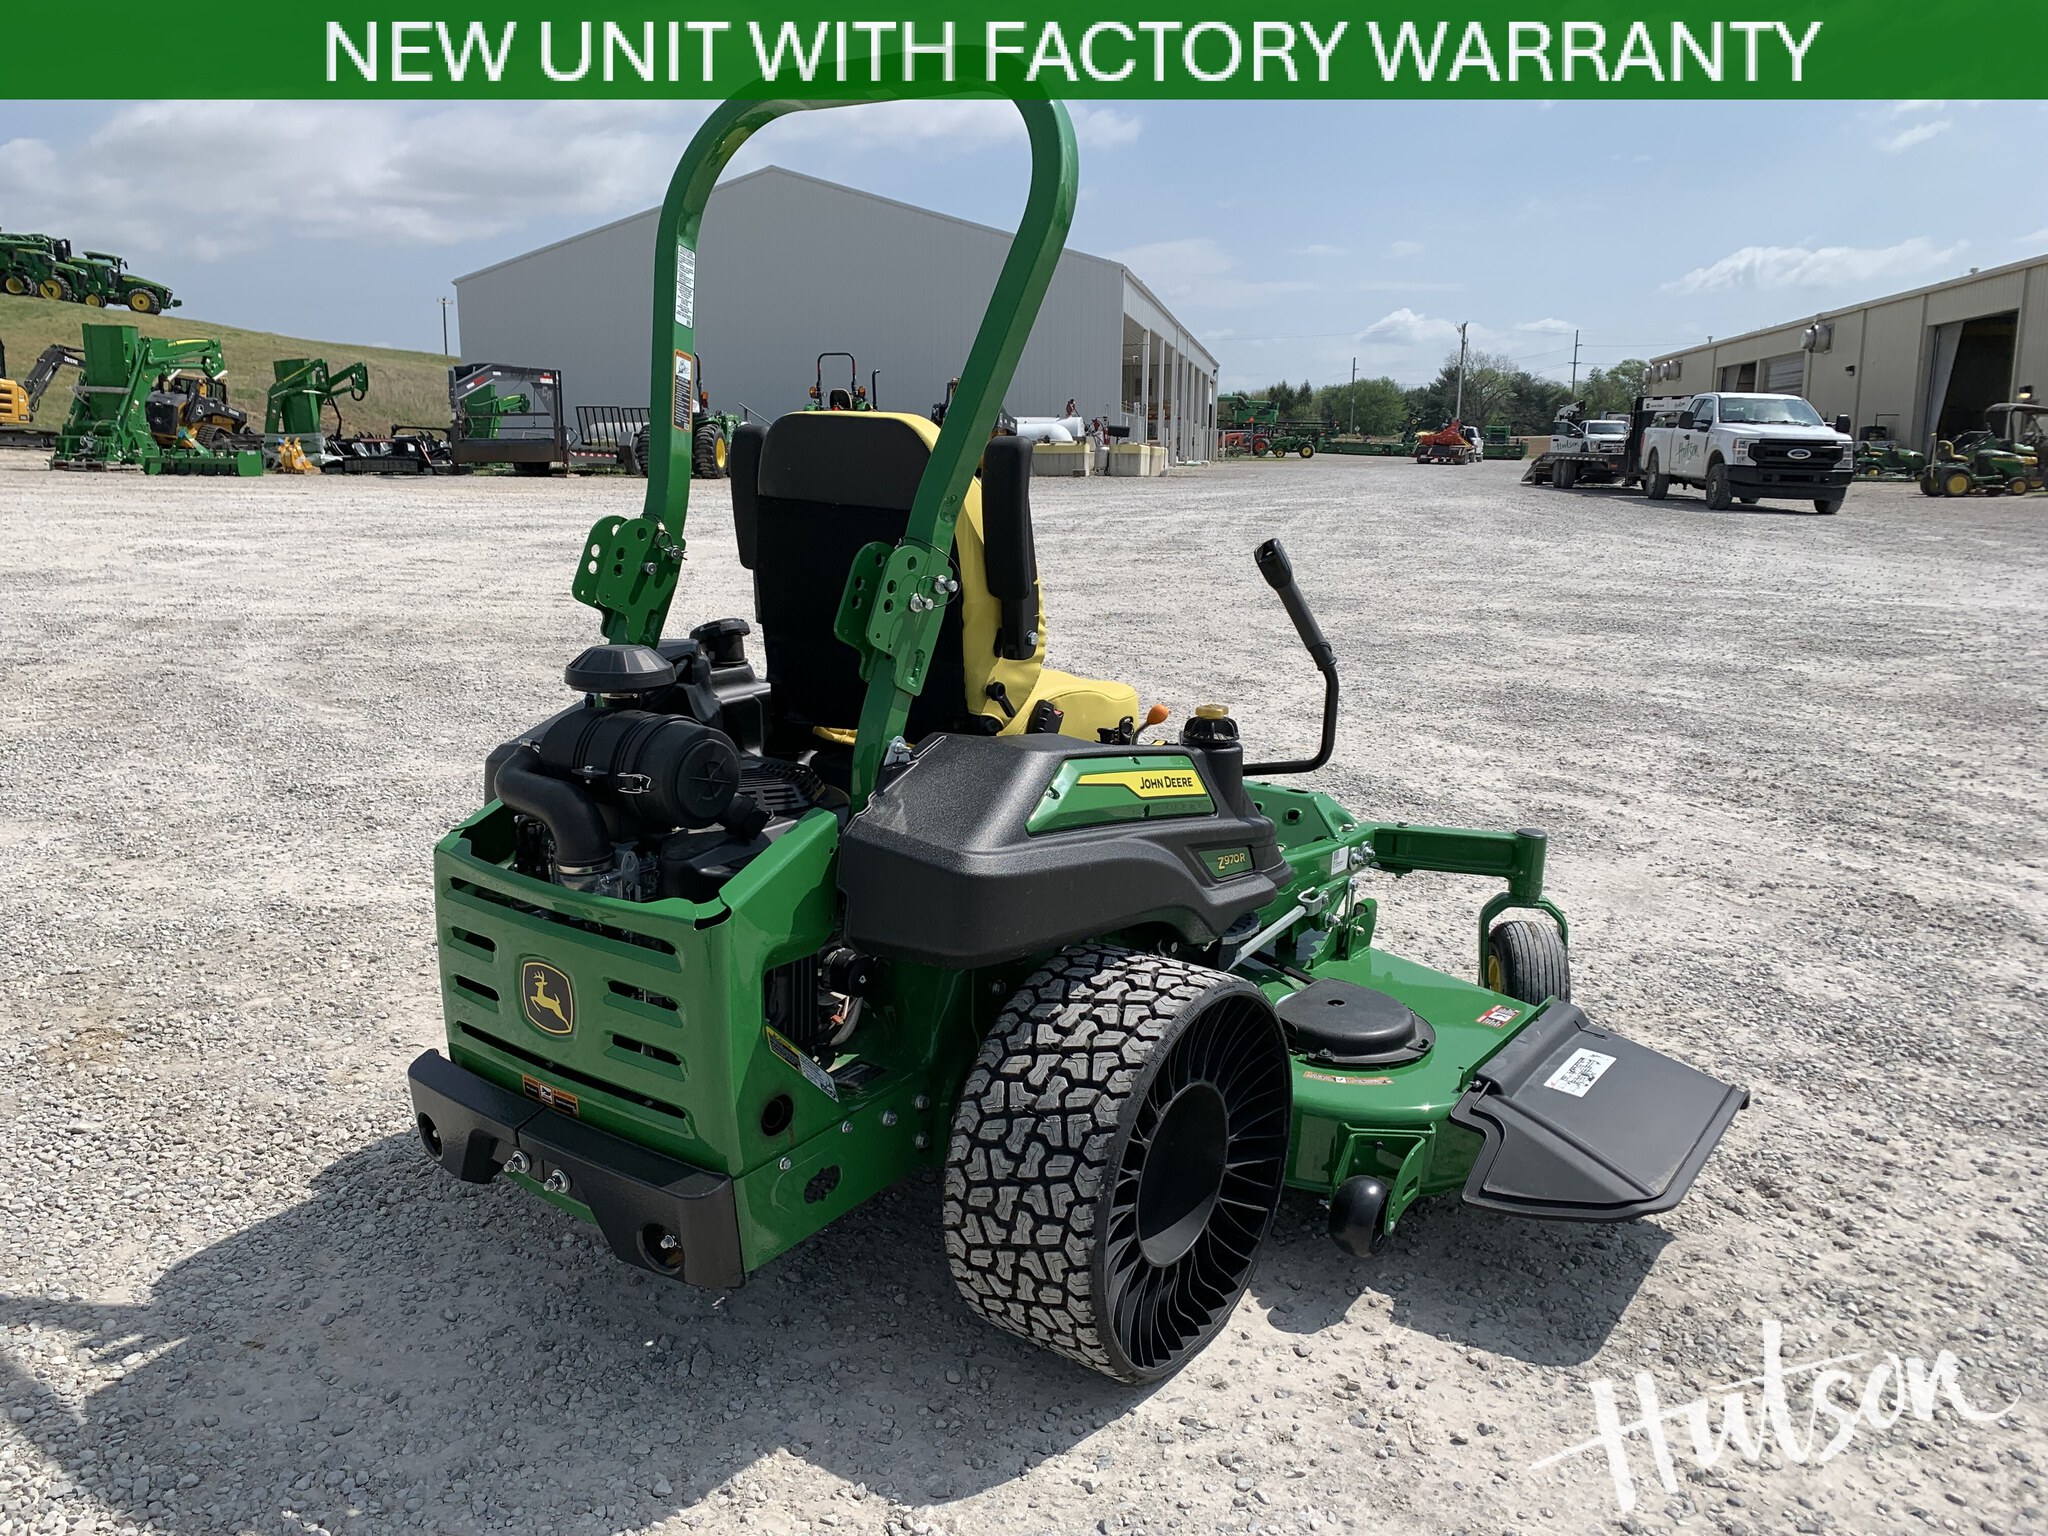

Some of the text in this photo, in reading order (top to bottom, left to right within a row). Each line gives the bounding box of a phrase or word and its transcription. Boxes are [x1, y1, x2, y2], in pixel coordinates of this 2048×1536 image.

[1140, 776, 1193, 789] JOHN DEERE
[1217, 852, 1246, 870] Z970R
